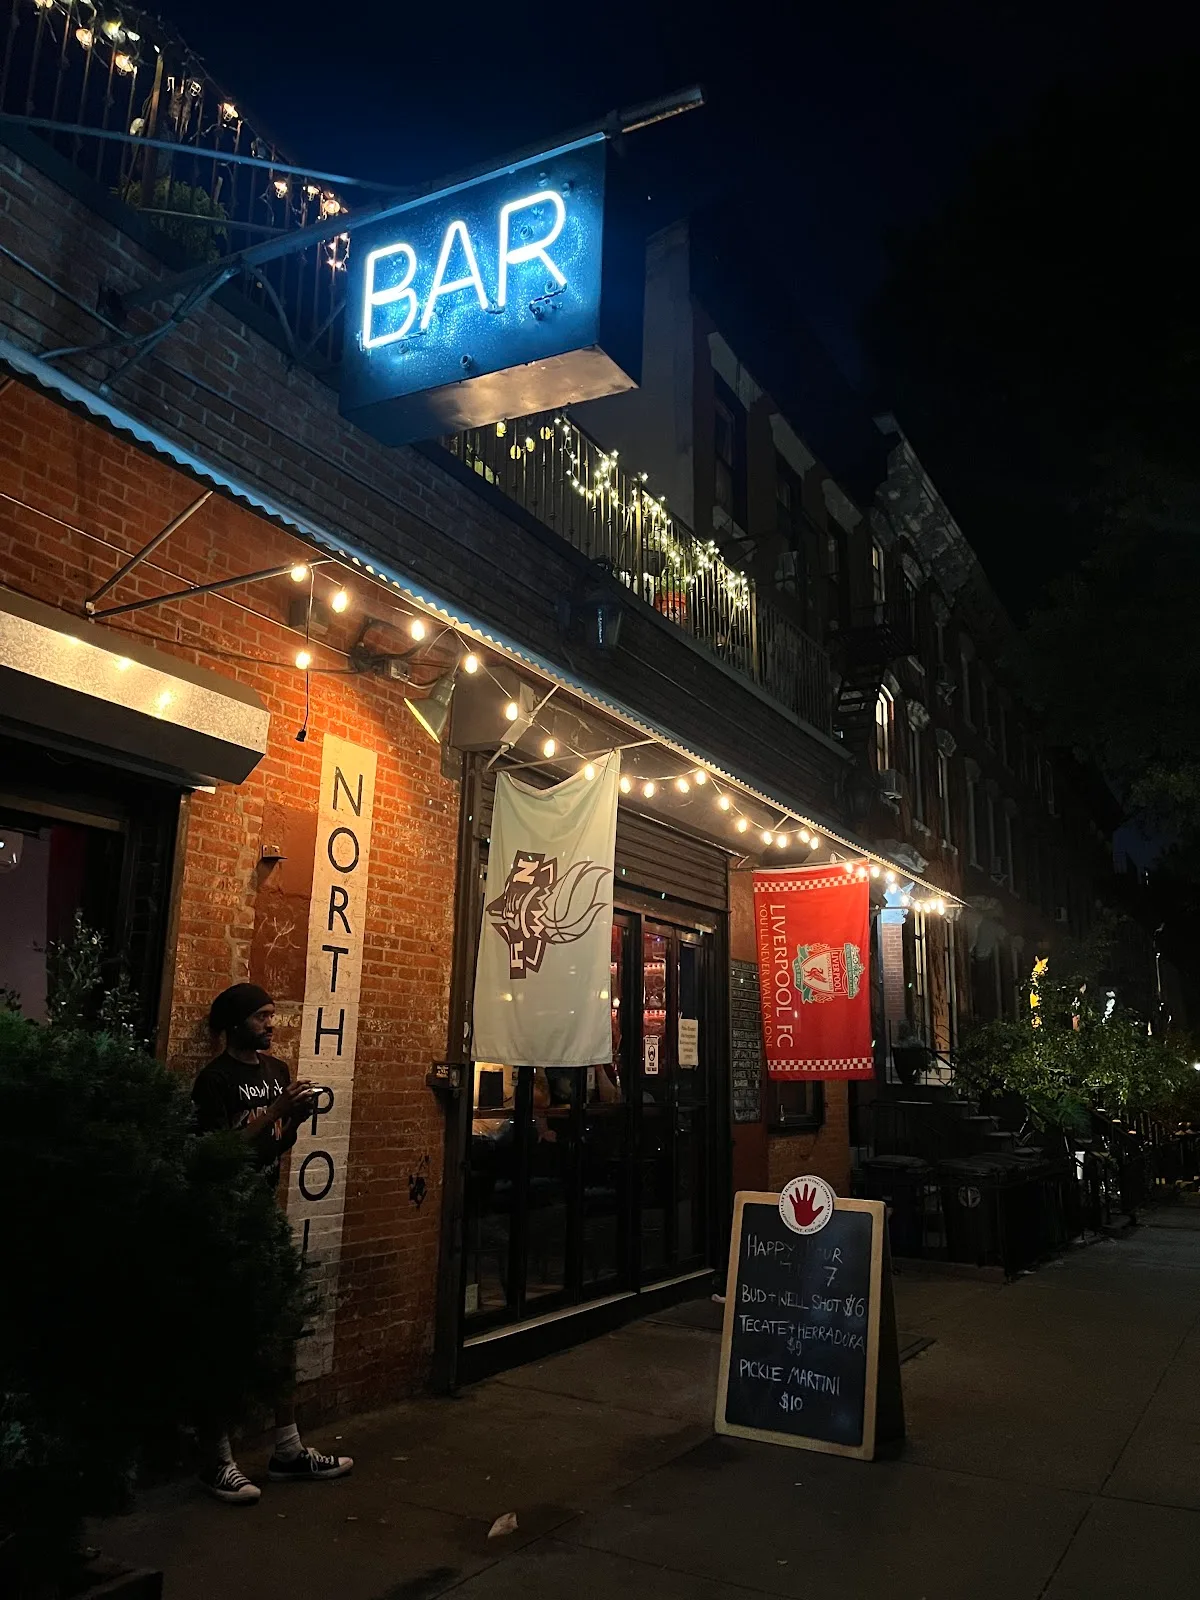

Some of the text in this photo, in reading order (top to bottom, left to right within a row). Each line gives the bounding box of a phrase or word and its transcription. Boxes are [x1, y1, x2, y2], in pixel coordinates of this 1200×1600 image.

[362, 190, 567, 350] BAR
[512, 858, 540, 885] N
[313, 766, 364, 1057] NORTH
[759, 903, 774, 1048] YOU'LL NEVER WALK ALONE
[770, 904, 794, 1048] LIVERPOOL FC
[831, 951, 842, 992] LIVERPOOL
[747, 1233, 795, 1260] HAPPY
[741, 1283, 767, 1303] BUD
[811, 1294, 842, 1313] SHOT
[843, 1294, 865, 1317] $6
[786, 1337, 802, 1356] $9
[740, 1358, 840, 1396] PICKLE MARTINI
[779, 1391, 803, 1412] $10
